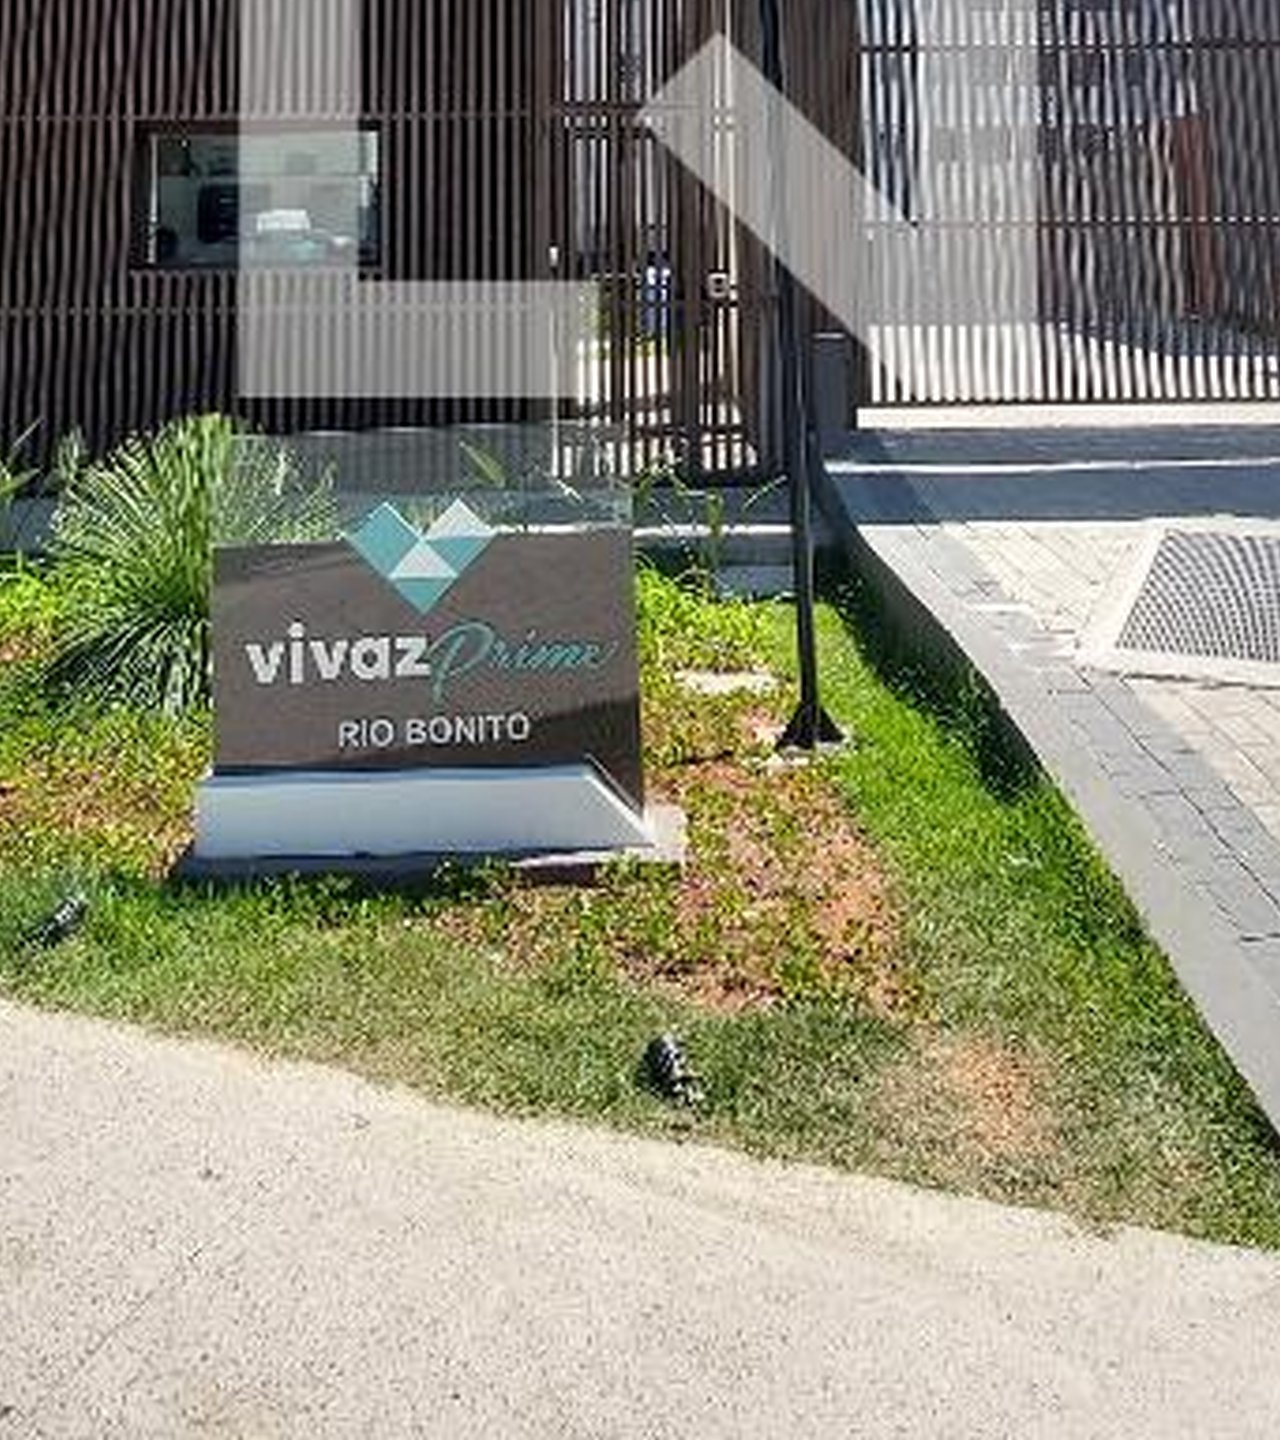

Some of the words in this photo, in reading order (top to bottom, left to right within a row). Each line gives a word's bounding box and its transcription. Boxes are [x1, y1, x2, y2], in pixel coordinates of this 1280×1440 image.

[245, 622, 431, 684] vivaz
[338, 718, 394, 749] RIO
[407, 711, 530, 746] BONITO
